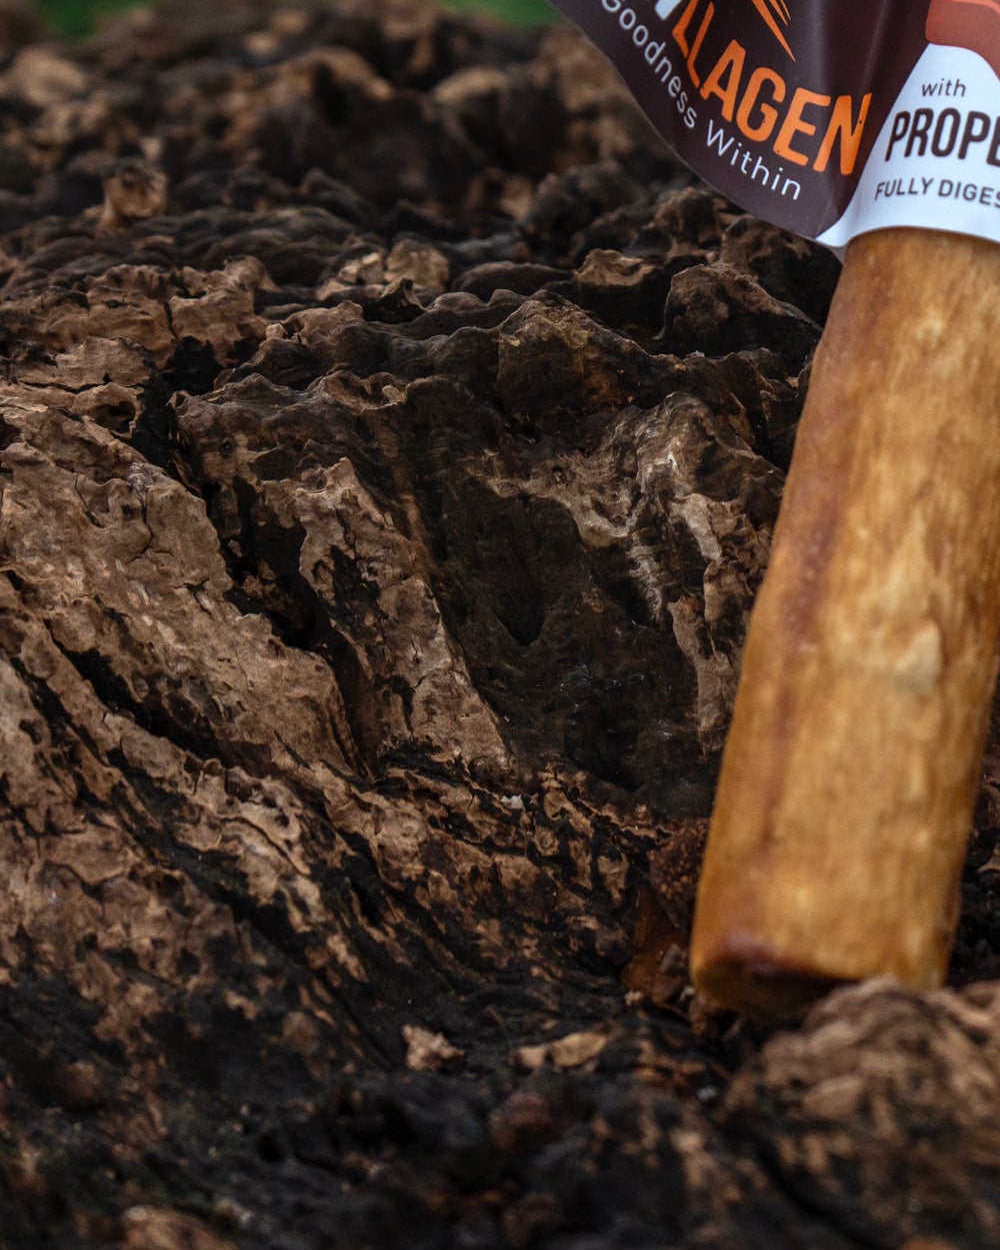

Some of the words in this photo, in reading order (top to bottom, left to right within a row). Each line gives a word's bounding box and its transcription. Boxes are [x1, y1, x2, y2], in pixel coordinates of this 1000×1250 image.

[921, 78, 966, 97] with
[705, 120, 801, 200] Within
[874, 177, 933, 200] FULLY
